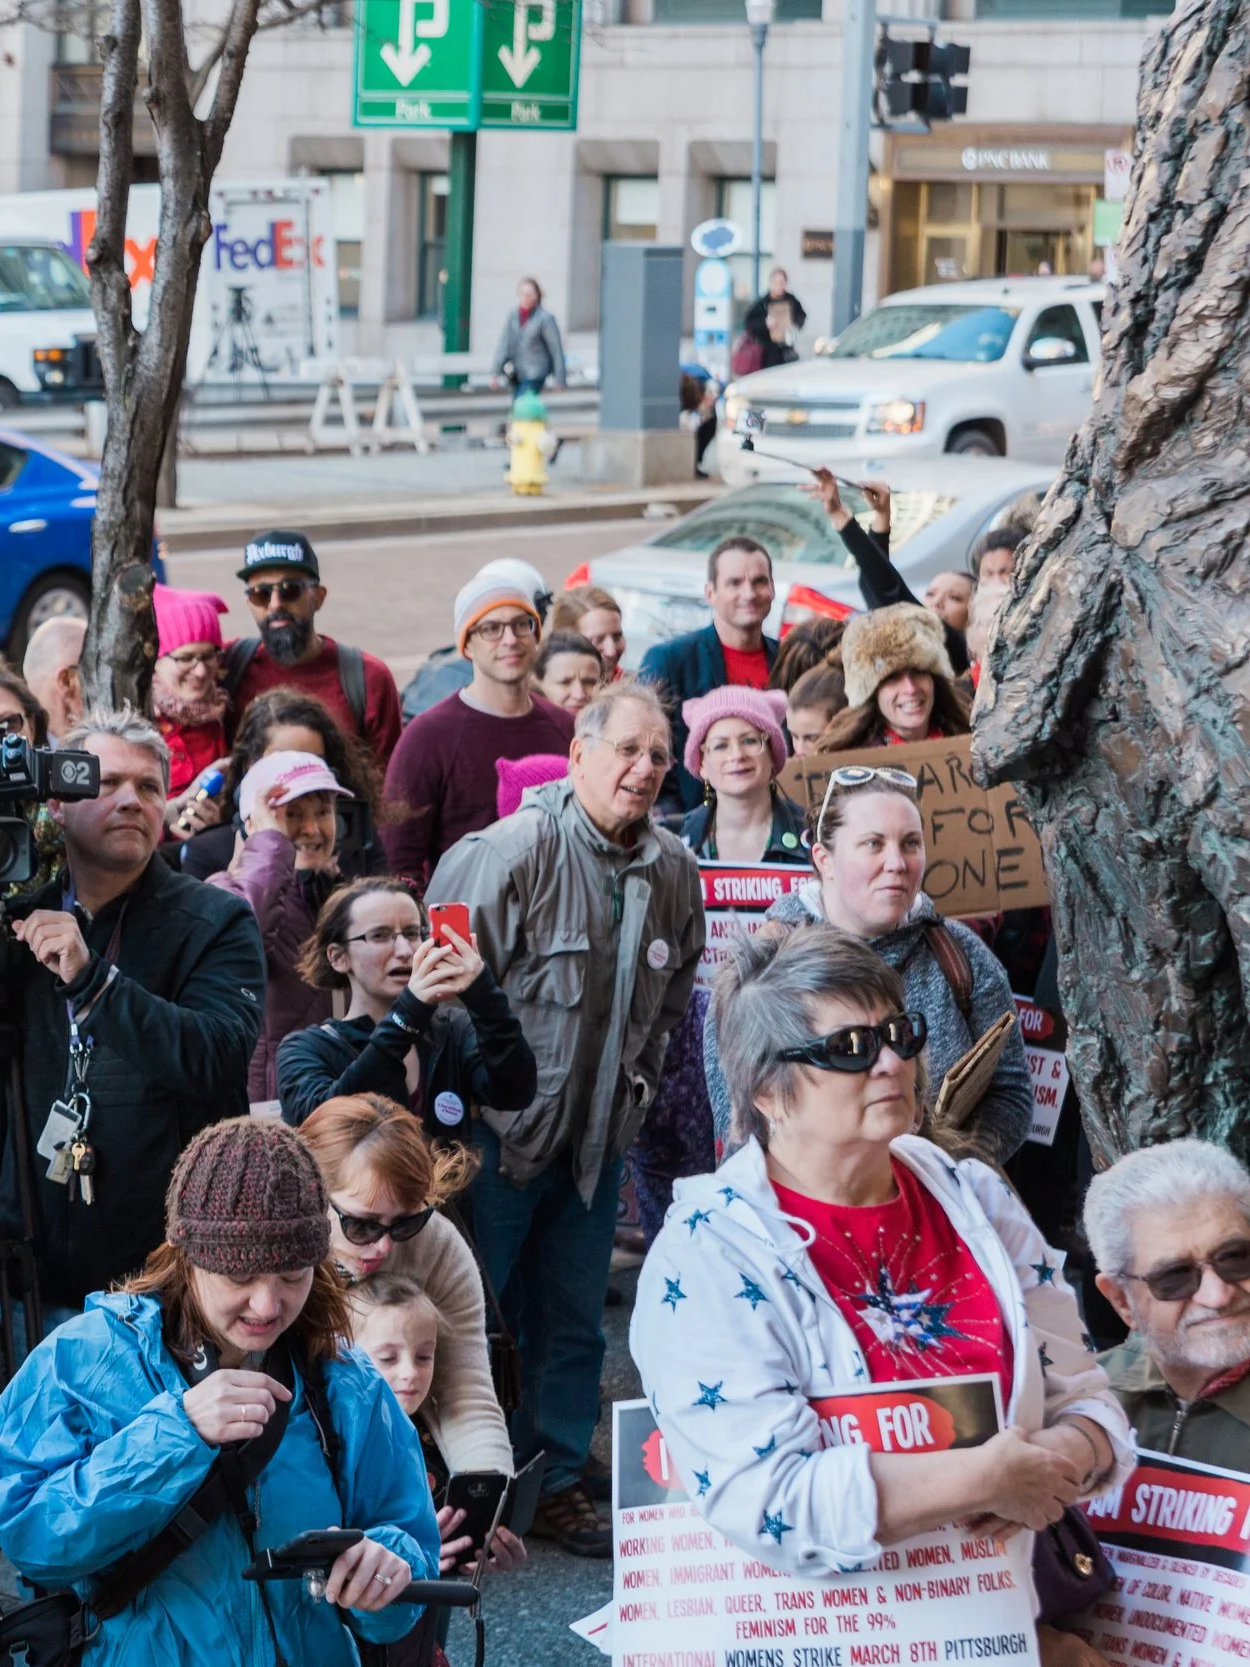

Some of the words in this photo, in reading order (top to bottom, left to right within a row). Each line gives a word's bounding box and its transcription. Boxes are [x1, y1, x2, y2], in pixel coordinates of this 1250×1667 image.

[395, 99, 432, 120] Park
[510, 100, 542, 121] Park
[978, 151, 1009, 170] PNC
[1010, 151, 1050, 170] BANK
[930, 800, 1041, 846] FOR
[713, 876, 783, 901] STRIKING
[1050, 1060, 1062, 1081] &
[1033, 1083, 1059, 1109] ISM.
[875, 1401, 936, 1453] FOR
[622, 1512, 635, 1525] FOR
[638, 1508, 665, 1524] WOMEN
[1130, 1483, 1238, 1537] STRIKING
[618, 1535, 666, 1559] WORKING
[671, 1531, 717, 1553] WOMEN,
[622, 1568, 663, 1591] WOMEN,
[669, 1561, 737, 1586] IMMIGRANT
[905, 1543, 955, 1569] WOMEN,
[618, 1601, 662, 1623] WOMEN,
[666, 1596, 719, 1620] LESBIAN,
[724, 1593, 768, 1615] QUEER,
[773, 1590, 816, 1611] TRANS
[821, 1586, 869, 1609] WOMEN
[876, 1585, 887, 1605] &
[894, 1575, 972, 1603] NON-BINARY
[977, 1569, 1017, 1593] FOLKS.
[1126, 1578, 1143, 1595] OF
[1177, 1587, 1215, 1614] NATIVE
[735, 1617, 797, 1640] FEMINISM
[804, 1617, 829, 1637] FOR
[835, 1614, 860, 1634] THE
[866, 1612, 897, 1631] 99%
[622, 1649, 717, 1667] INTERNATIONAL
[724, 1649, 784, 1667] WOMENS
[792, 1646, 843, 1667] STRIKE
[849, 1643, 901, 1667] MARCH
[909, 1640, 938, 1664] 8TH
[943, 1632, 1029, 1662] PITTSBURGH
